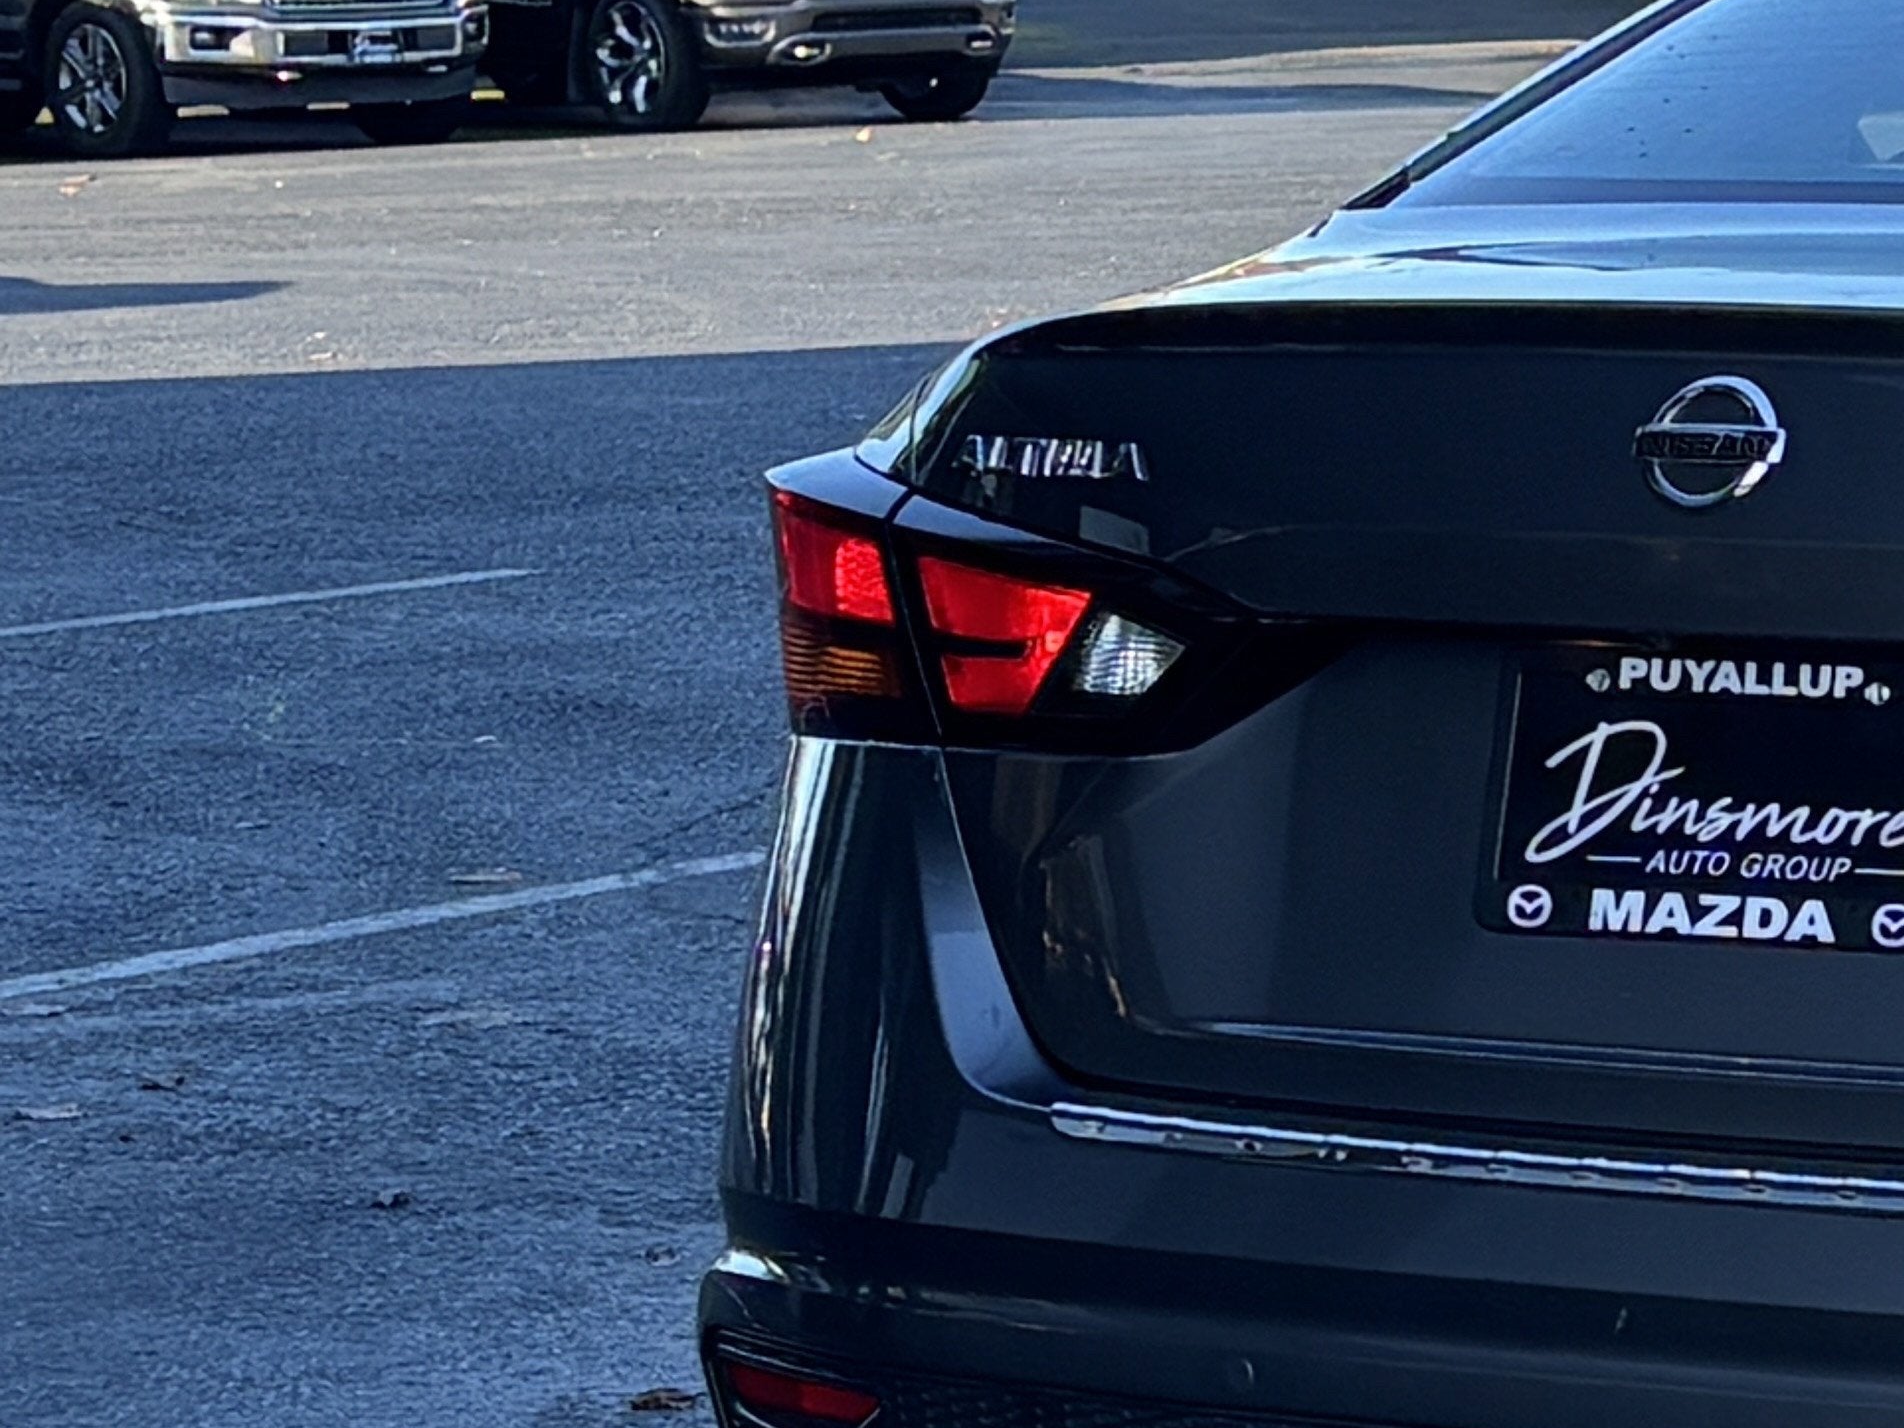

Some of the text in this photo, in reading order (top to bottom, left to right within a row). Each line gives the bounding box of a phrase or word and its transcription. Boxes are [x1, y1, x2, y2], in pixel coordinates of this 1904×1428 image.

[1618, 657, 1864, 699] PUYALLUP
[1645, 849, 1852, 882] AUTO GROUP
[1588, 888, 1836, 943] MAZDA
